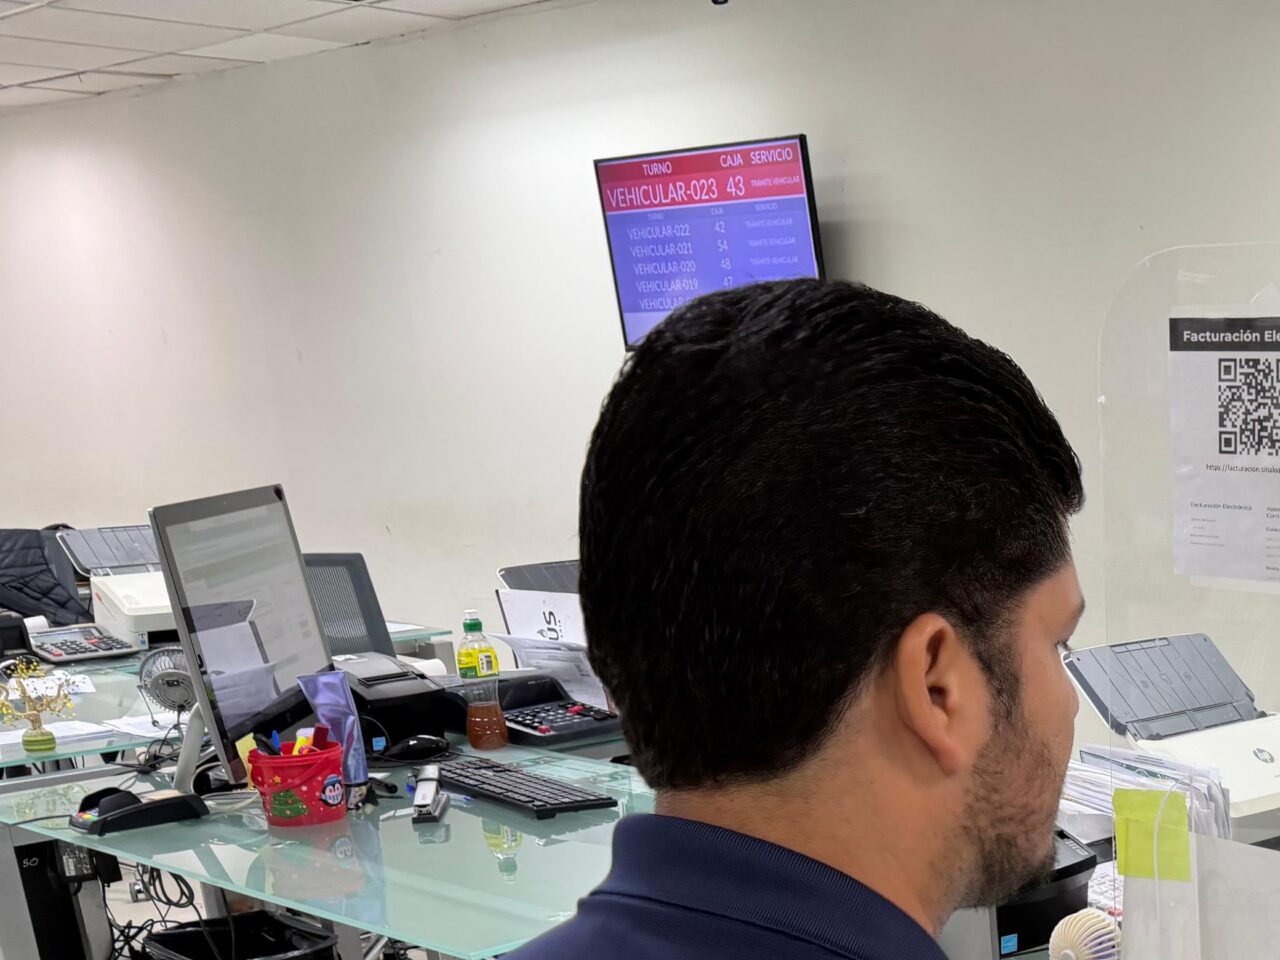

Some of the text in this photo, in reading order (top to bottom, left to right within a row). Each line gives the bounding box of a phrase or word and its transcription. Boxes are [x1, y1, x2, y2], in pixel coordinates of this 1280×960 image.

[642, 147, 793, 176] TURNO CAJA SERVICIO
[607, 178, 718, 208] VEHICULAR-023
[726, 176, 745, 196] 43
[627, 224, 690, 240] VEHICULAR-022
[714, 222, 726, 234] 42
[630, 243, 693, 258] VEHICULAR-021
[717, 240, 728, 252] 54
[633, 260, 696, 275] VEHICULAR-020
[720, 258, 731, 270] 48
[636, 276, 733, 293] VEHICULAR-019 47
[1183, 330, 1261, 343] Facturación
